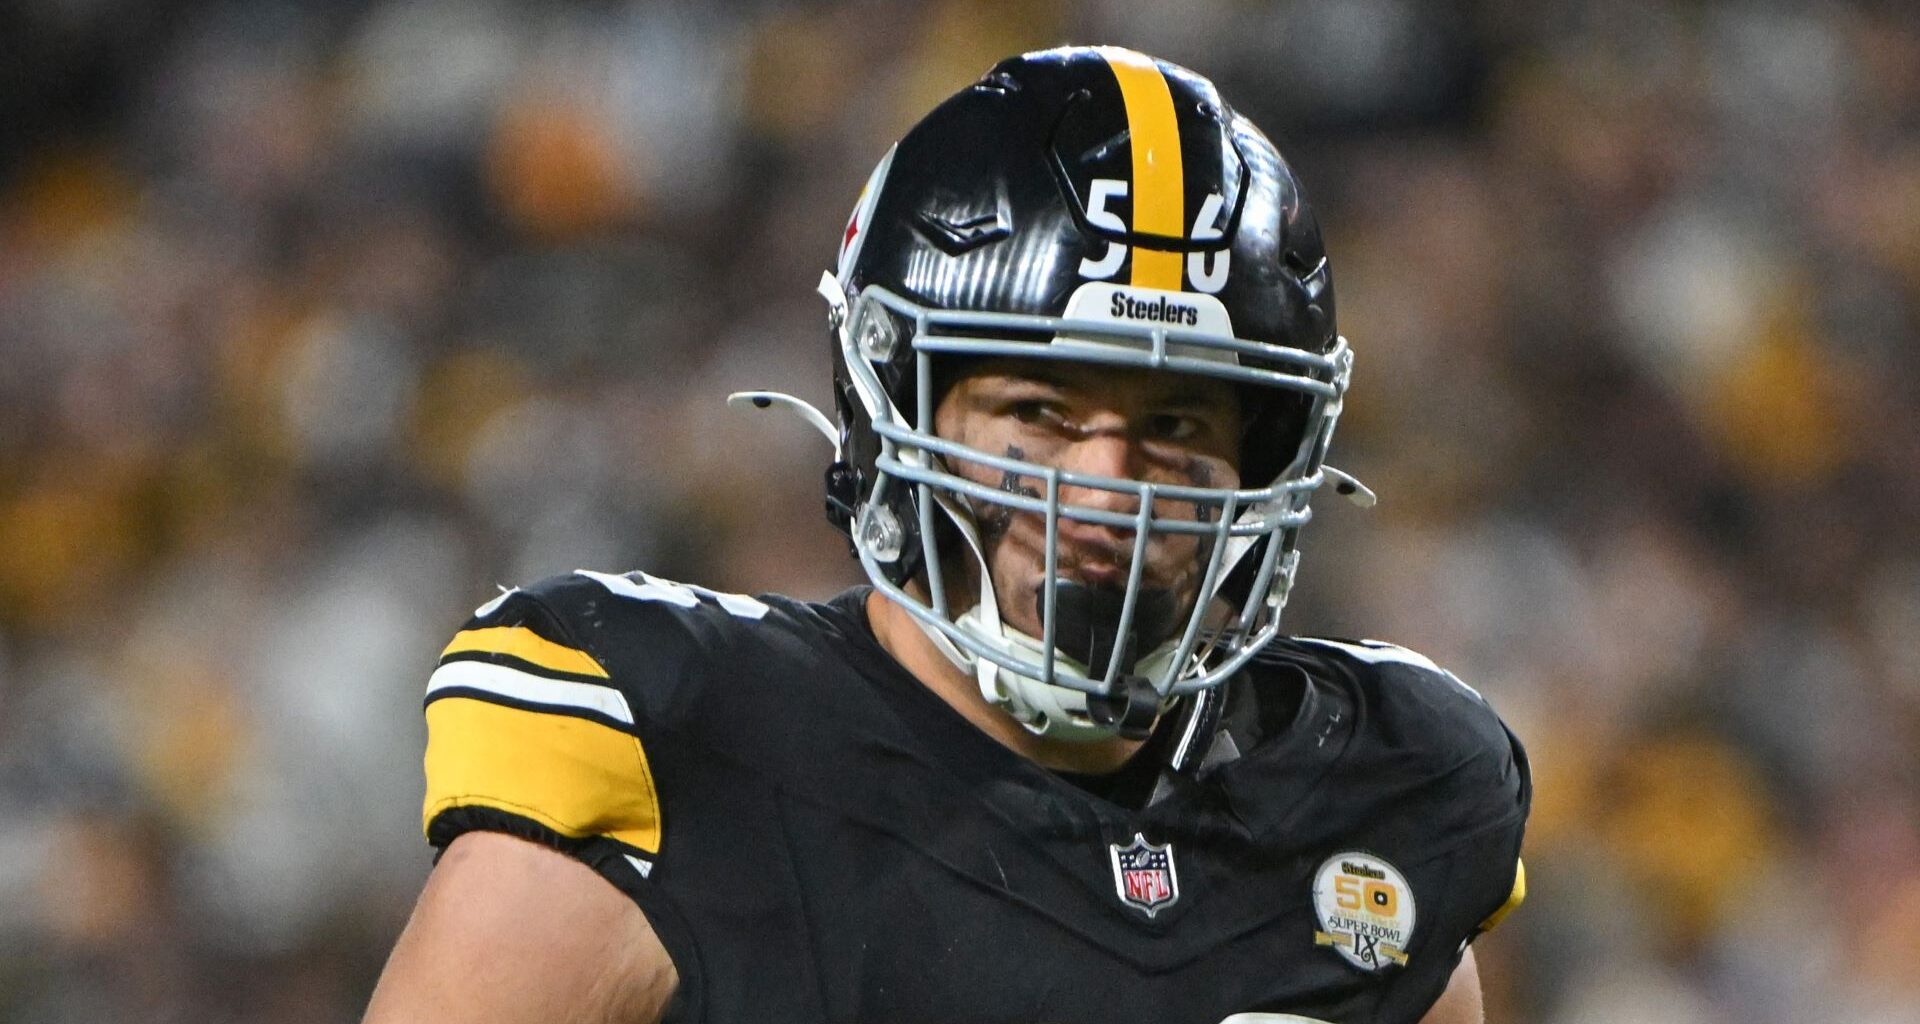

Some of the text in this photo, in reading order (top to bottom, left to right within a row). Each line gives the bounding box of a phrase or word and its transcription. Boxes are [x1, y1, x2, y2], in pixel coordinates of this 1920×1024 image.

[1111, 291, 1198, 326] Steelers
[1126, 870, 1169, 902] NFL
[1335, 875, 1397, 917] 50
[1328, 915, 1368, 934] SUPER
[1371, 925, 1401, 943] BOWL
[1353, 933, 1379, 968] IX
